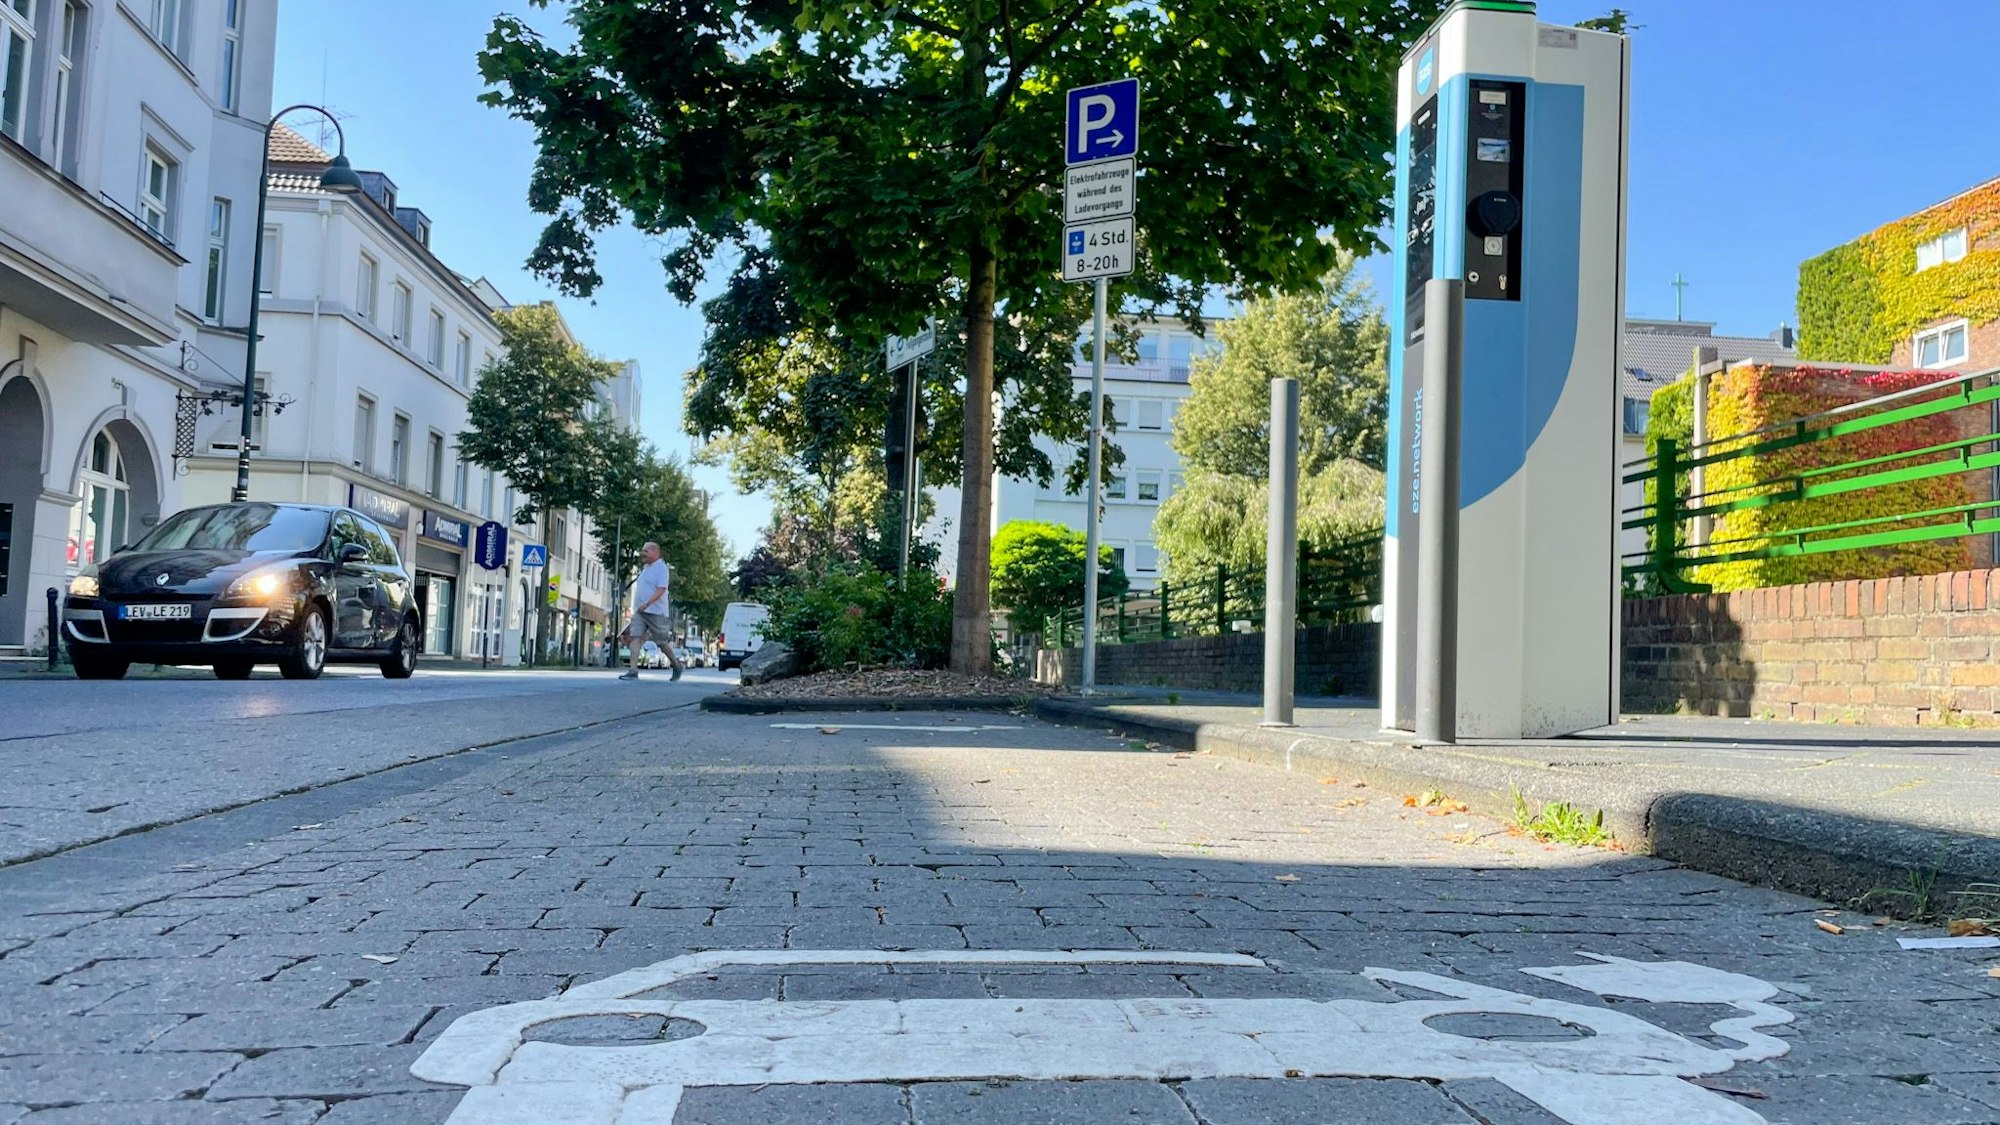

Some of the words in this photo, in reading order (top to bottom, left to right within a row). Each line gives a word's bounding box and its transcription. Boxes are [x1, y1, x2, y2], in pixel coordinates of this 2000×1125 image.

[1077, 94, 1116, 154] P
[1070, 167, 1130, 185] Elektrofahrzeuge
[1077, 185, 1107, 199] während
[1109, 184, 1122, 195] des
[1074, 199, 1123, 215] Ladevorgangs
[1089, 233, 1097, 248] 4
[1101, 229, 1129, 246] Std.
[1077, 254, 1119, 273] 8-20h
[1411, 386, 1423, 514] eze.network
[434, 516, 462, 539] ADMIRAL
[485, 523, 496, 568] ADMIRAL
[126, 606, 146, 618] LEV
[153, 606, 167, 617] LE
[170, 605, 190, 617] 219
